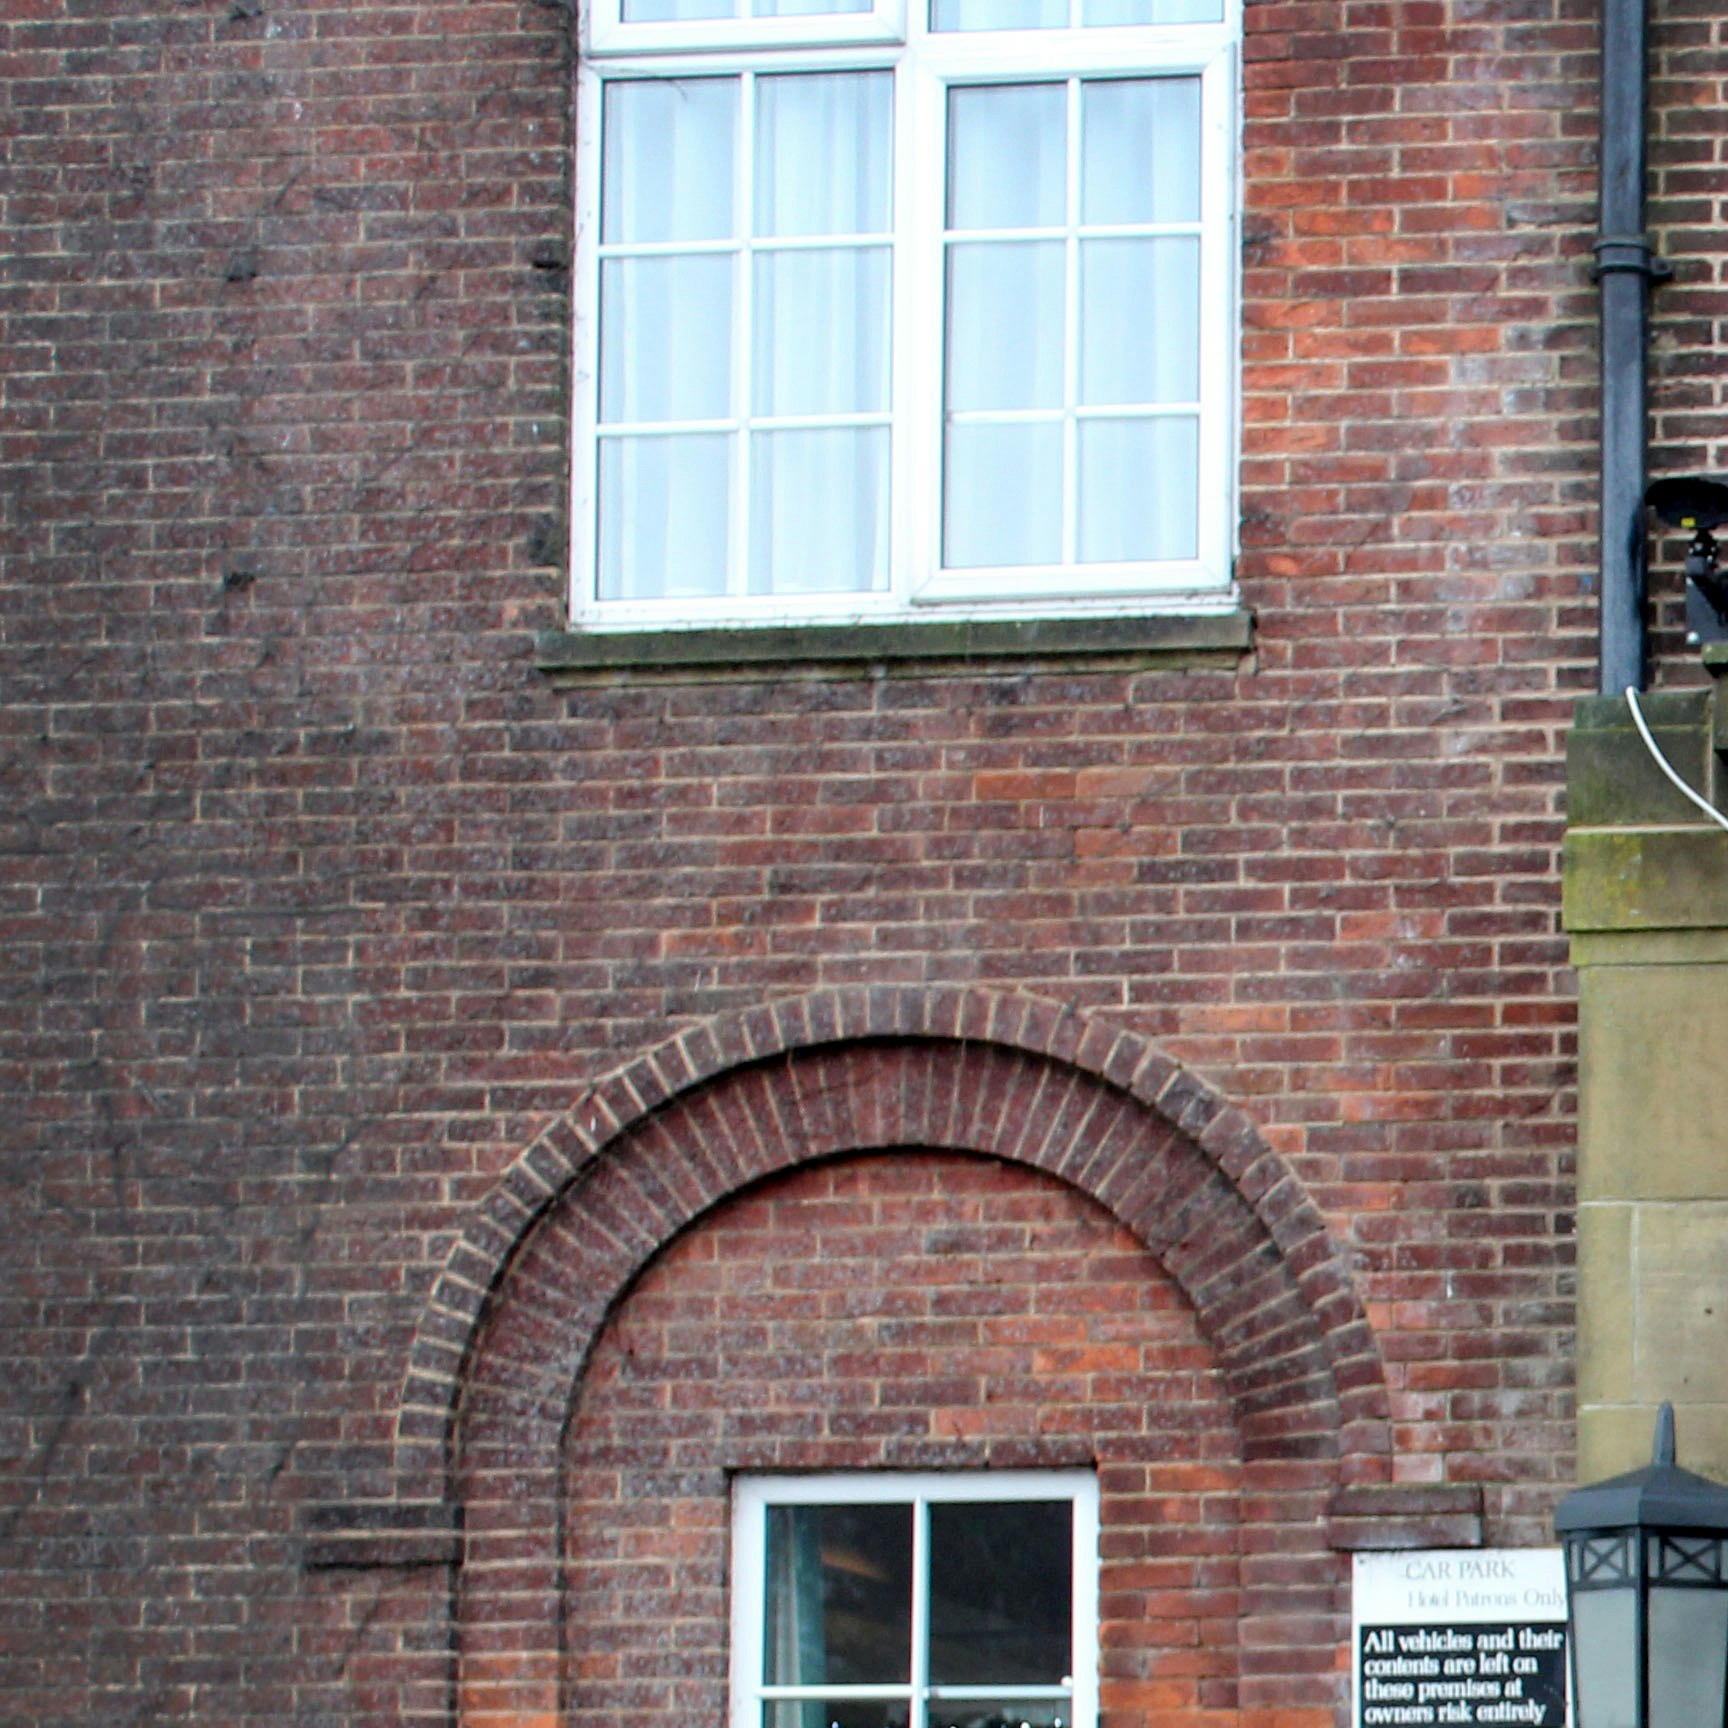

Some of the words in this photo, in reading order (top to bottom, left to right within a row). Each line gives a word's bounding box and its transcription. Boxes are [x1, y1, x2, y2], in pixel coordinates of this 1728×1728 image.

[1405, 1560, 1451, 1580] CAR
[1459, 1559, 1514, 1579] PARK
[1408, 1588, 1449, 1608] Hotel
[1456, 1589, 1517, 1607] Patrons
[1523, 1586, 1566, 1608] Only
[1364, 1629, 1395, 1653] All
[1398, 1628, 1474, 1652] vehicles
[1476, 1627, 1515, 1650] and
[1518, 1626, 1563, 1649] their
[1363, 1655, 1440, 1676] contents
[1443, 1657, 1476, 1675] are
[1479, 1651, 1509, 1674] left
[1512, 1656, 1538, 1673] on
[1364, 1678, 1414, 1700] these
[1418, 1677, 1500, 1704] premises
[1504, 1677, 1523, 1698] at
[1364, 1704, 1435, 1724] owners
[1438, 1699, 1474, 1722] risk
[1476, 1698, 1546, 1726] entirely
